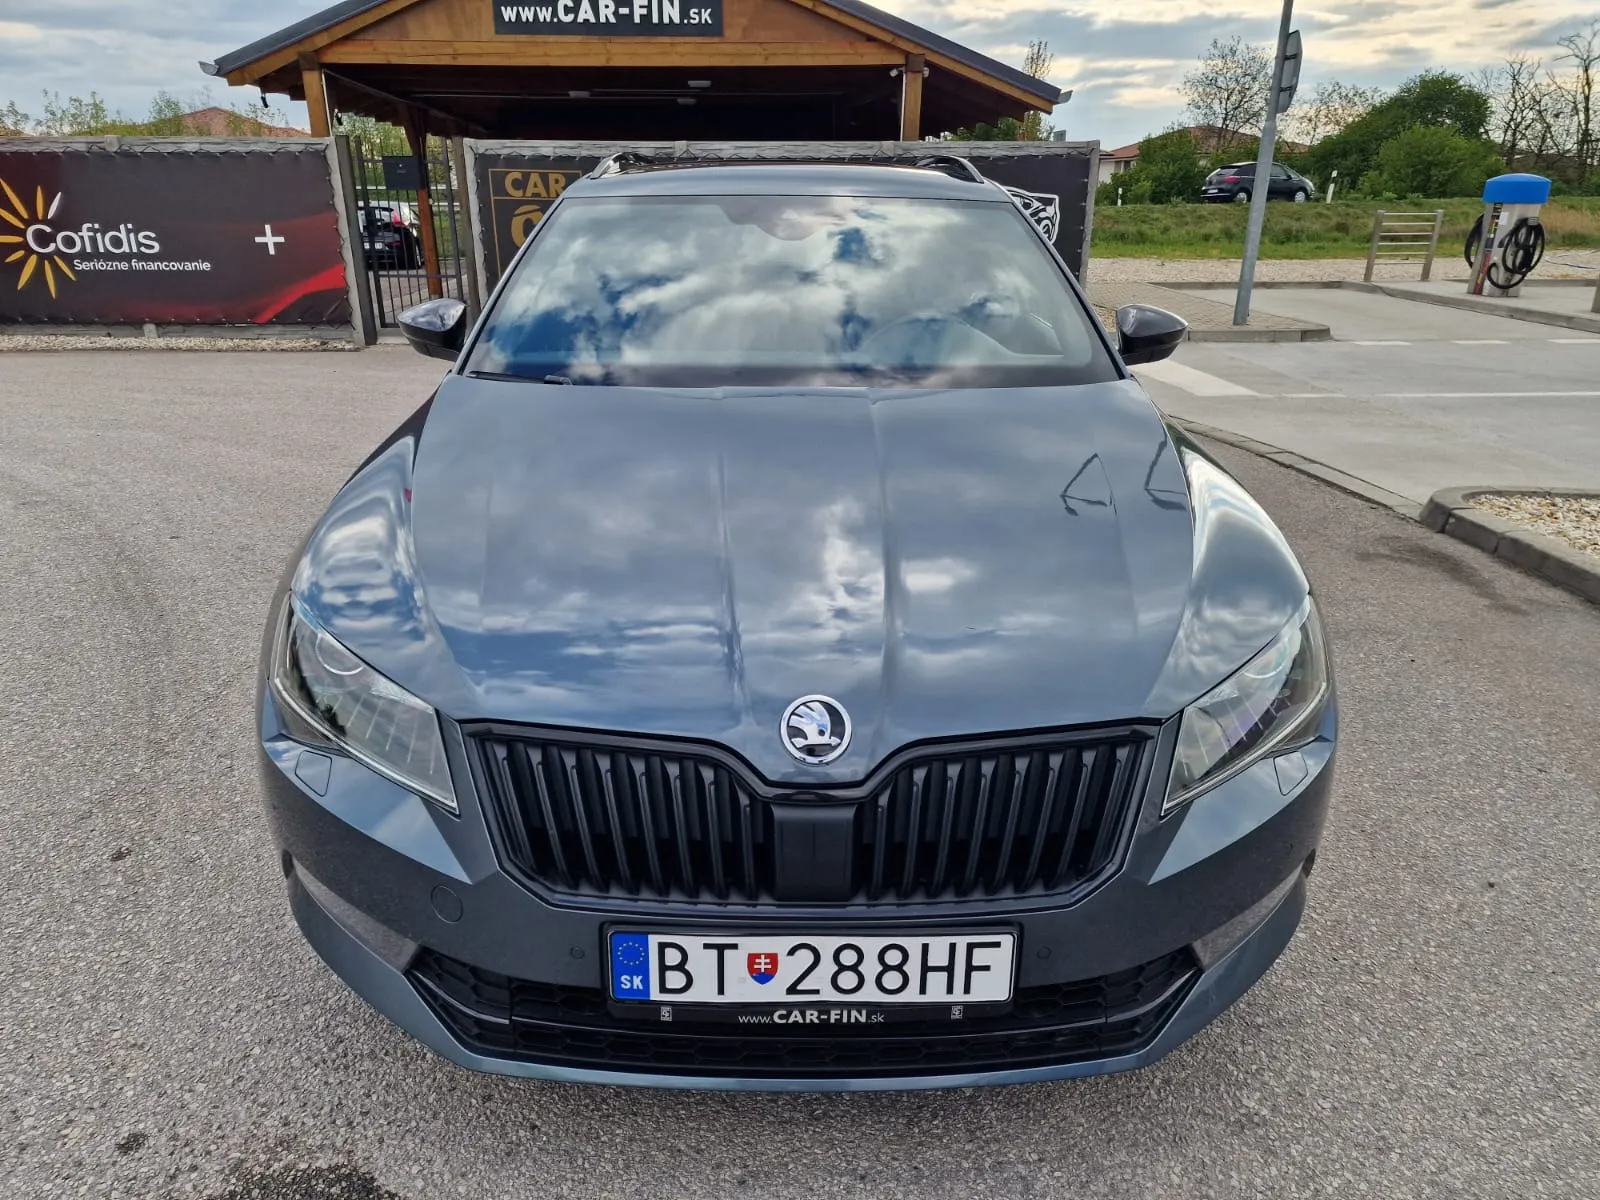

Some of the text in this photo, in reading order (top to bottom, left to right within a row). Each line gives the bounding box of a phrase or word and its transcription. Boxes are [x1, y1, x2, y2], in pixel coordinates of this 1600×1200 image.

[504, 171, 566, 198] CAR
[26, 223, 160, 254] Cofidis
[73, 258, 212, 272] Seriózne financovanie
[657, 941, 1001, 996] BT 288HF
[620, 975, 644, 990] SK
[738, 1009, 885, 1025] www.CAR-FIN.sk
